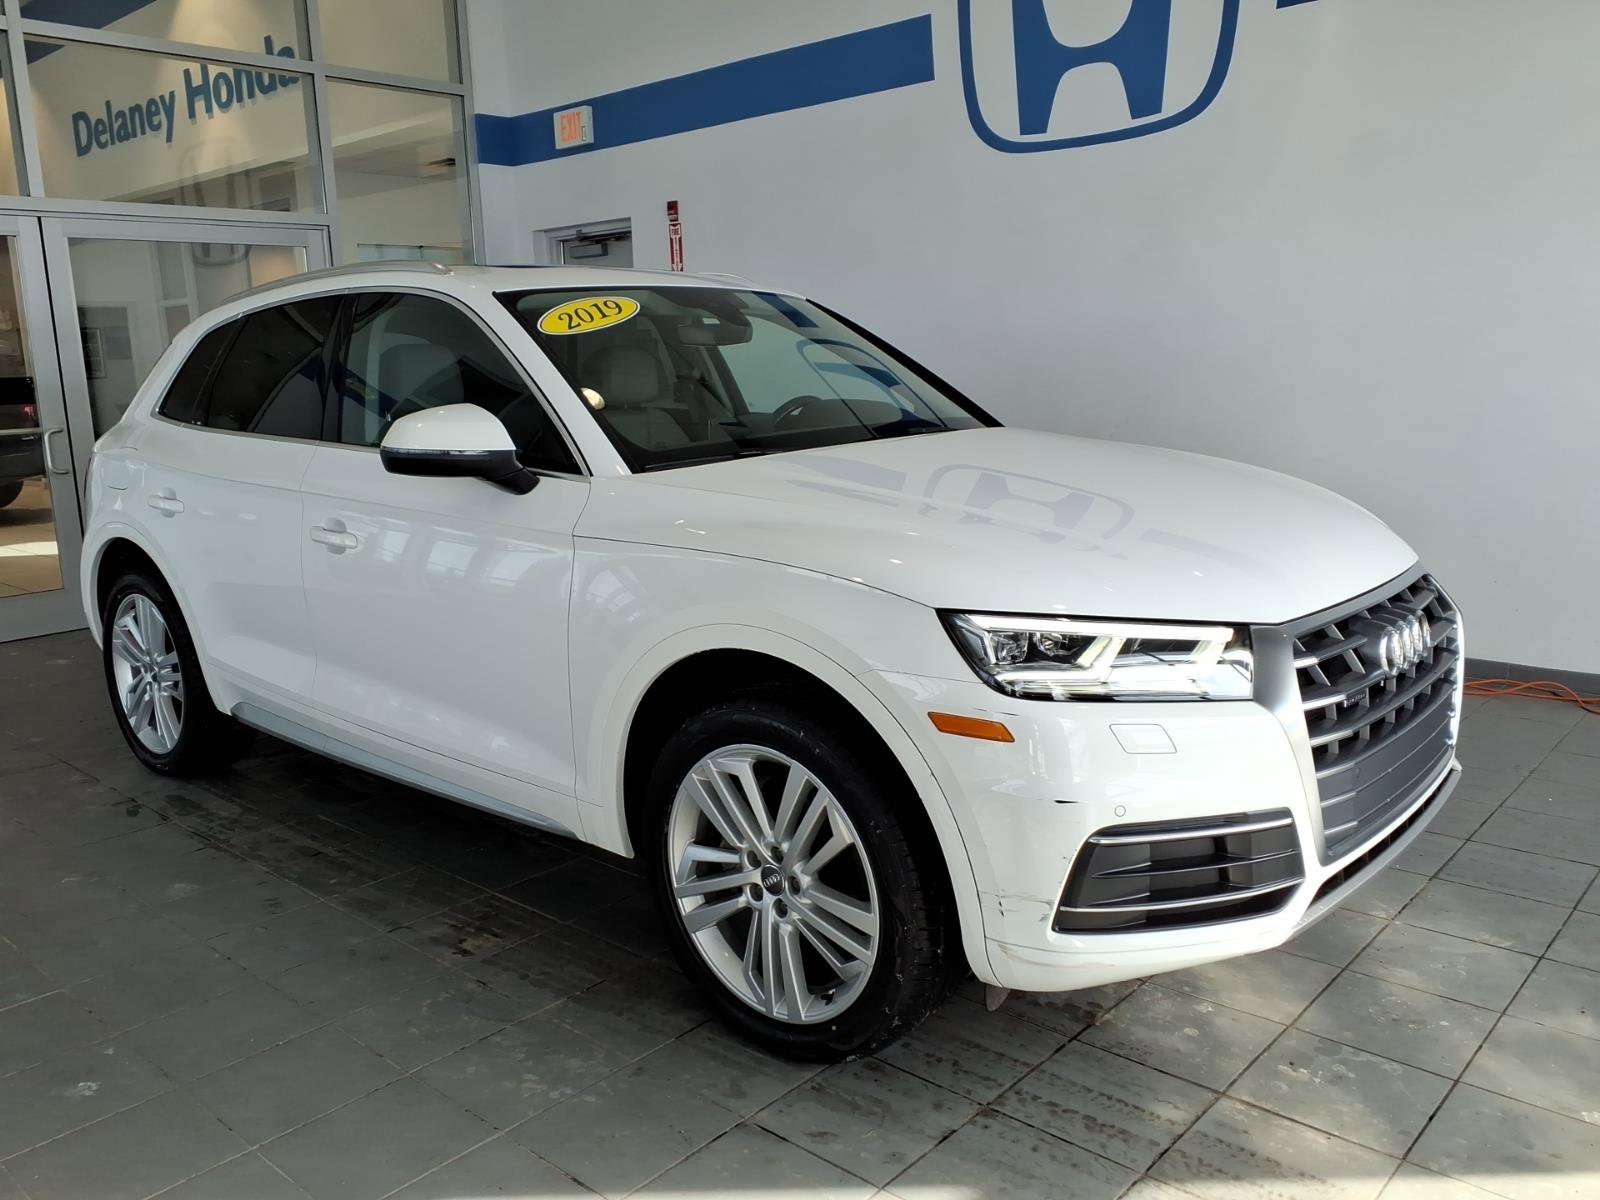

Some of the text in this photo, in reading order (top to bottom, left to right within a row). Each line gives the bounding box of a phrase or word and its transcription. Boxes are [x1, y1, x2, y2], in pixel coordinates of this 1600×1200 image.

[72, 90, 176, 157] Delaney
[560, 112, 582, 143] EXIT
[558, 299, 623, 330] 2019
